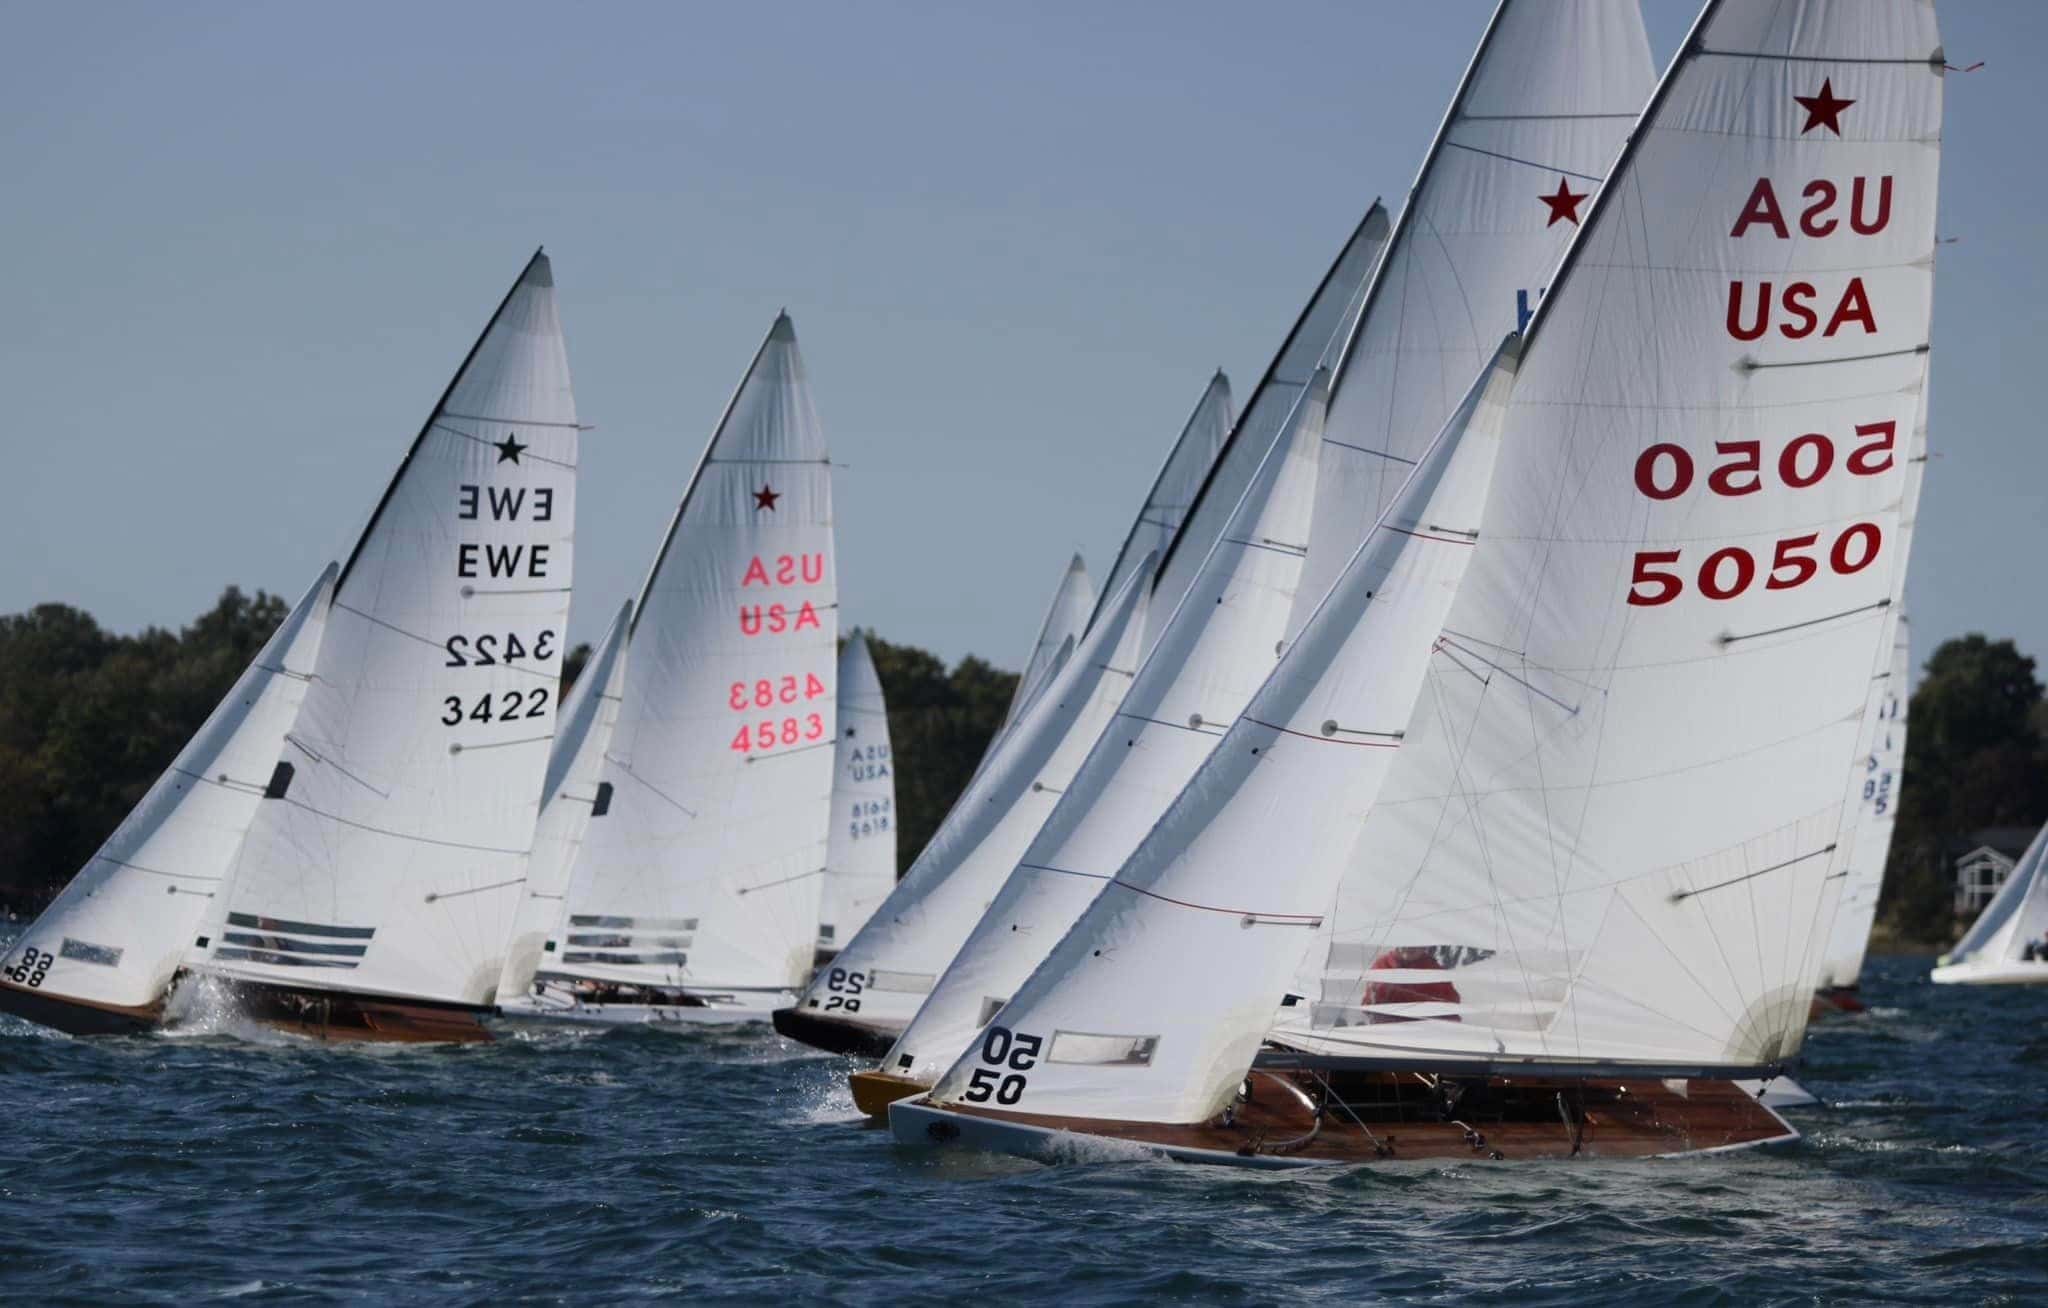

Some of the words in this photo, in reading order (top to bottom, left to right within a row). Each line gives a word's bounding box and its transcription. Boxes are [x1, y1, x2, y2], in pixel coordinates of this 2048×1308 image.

[1726, 277, 1877, 341] USA
[457, 544, 550, 578] EWE
[1626, 522, 1883, 606] 5050
[740, 601, 821, 637] USA
[441, 688, 549, 727] 3422
[730, 712, 825, 754] 4583
[965, 1068, 1027, 1105] 50
